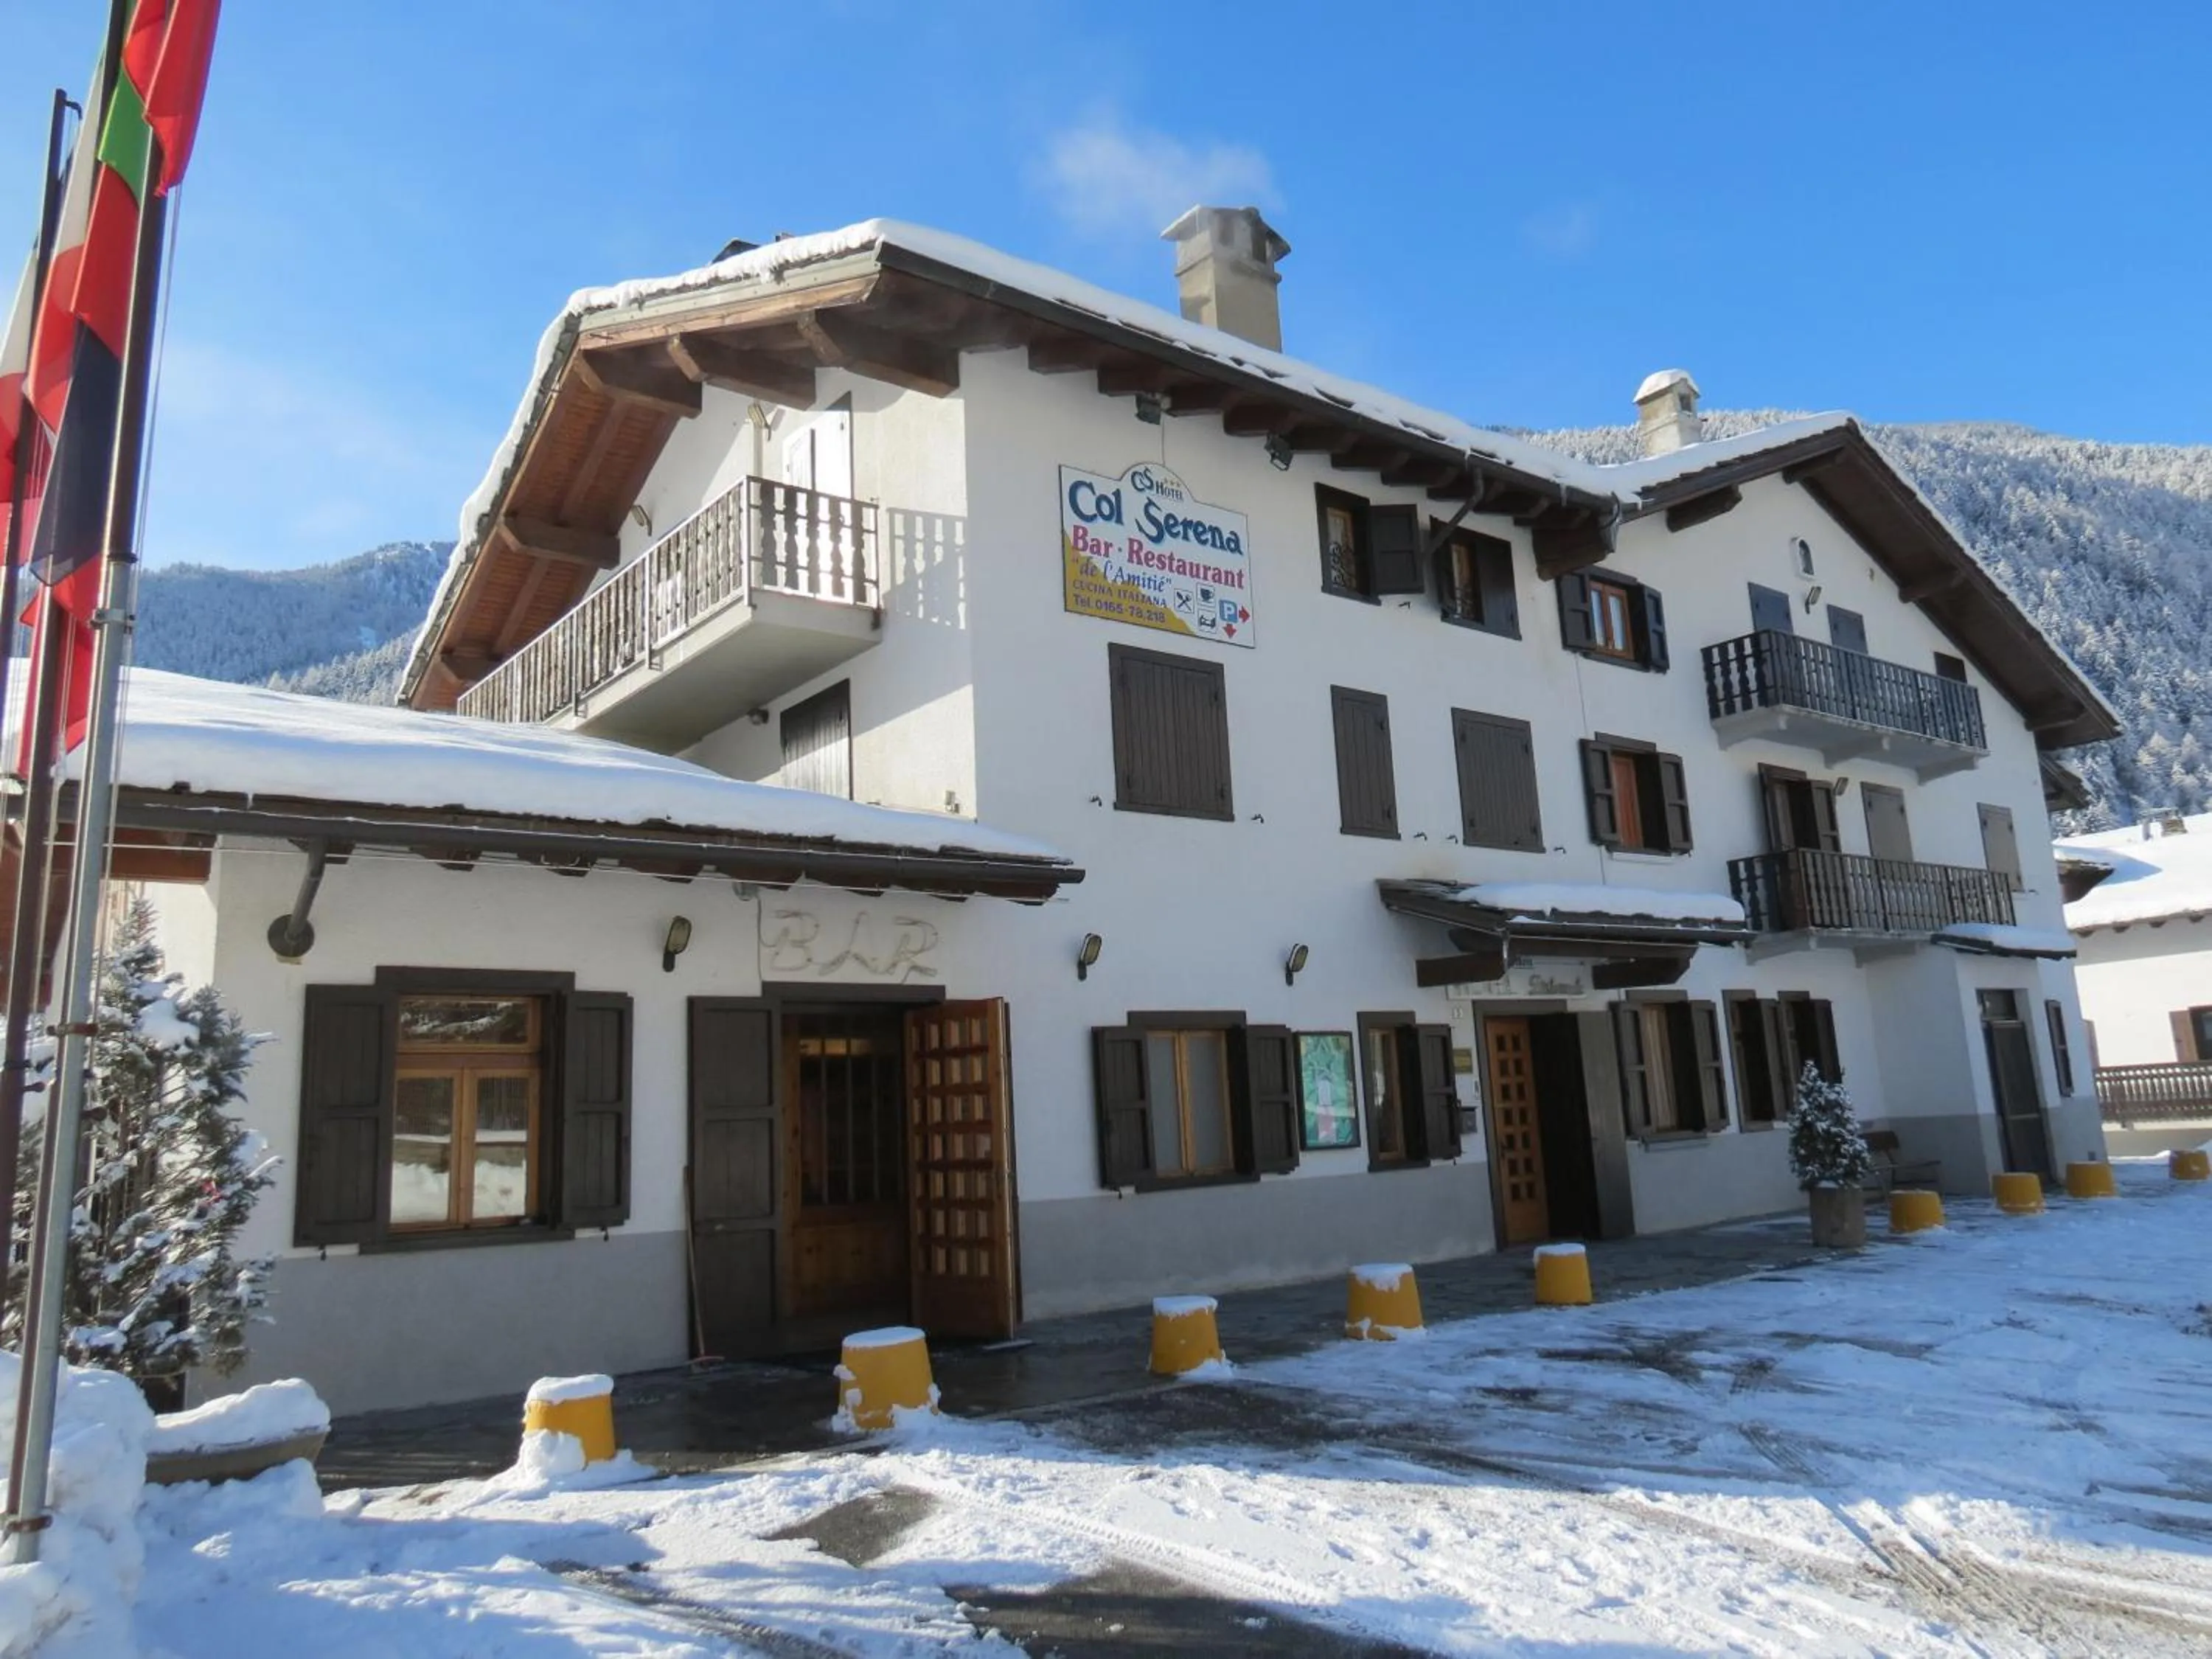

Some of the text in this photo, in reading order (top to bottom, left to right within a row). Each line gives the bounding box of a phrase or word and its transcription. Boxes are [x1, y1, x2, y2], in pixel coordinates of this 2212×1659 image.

[1068, 480, 1243, 555] Col Serena
[1073, 524, 1245, 589] Bar Restaurant
[1073, 579, 1113, 597] CUCINA
[1222, 606, 1234, 620] P
[767, 909, 939, 976] BAR
